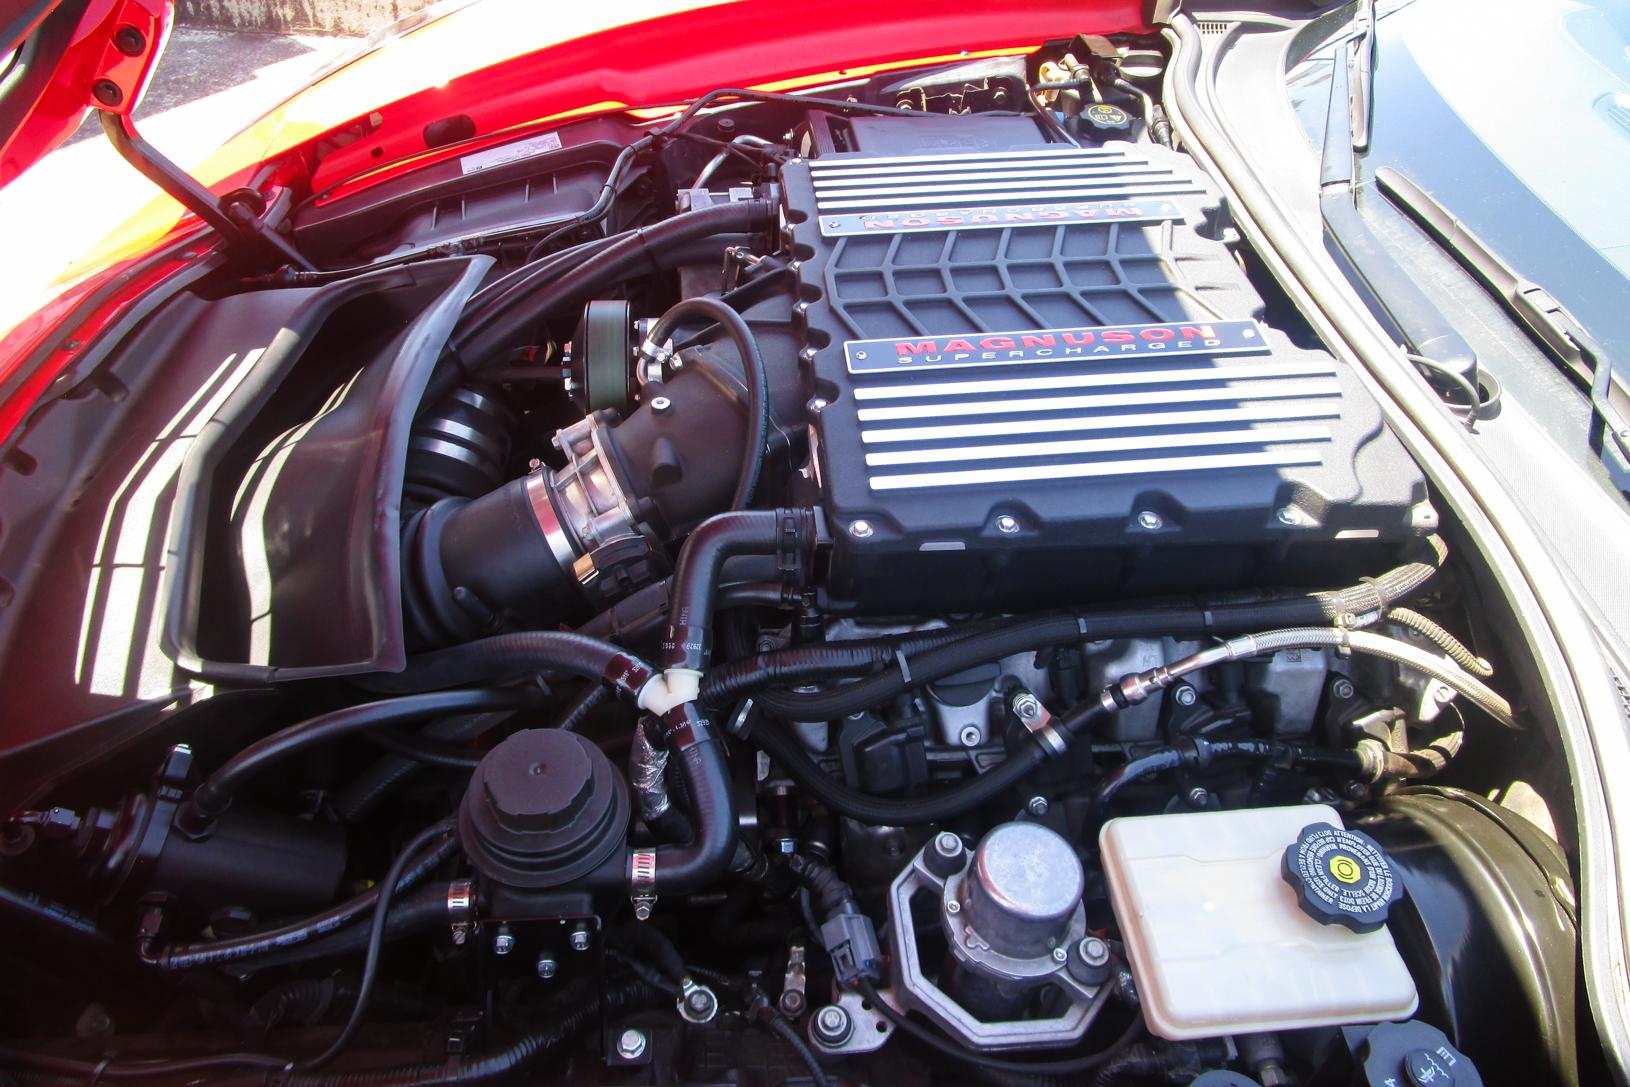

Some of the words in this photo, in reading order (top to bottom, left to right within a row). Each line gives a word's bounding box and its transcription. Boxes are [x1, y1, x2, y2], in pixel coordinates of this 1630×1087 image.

[863, 207, 1142, 230] MAGNUSON
[895, 325, 1217, 355] MAGNUSON
[897, 339, 1221, 363] SUPERCHARGED
[1313, 877, 1326, 889] USE
[1321, 875, 1340, 892] FILLER
